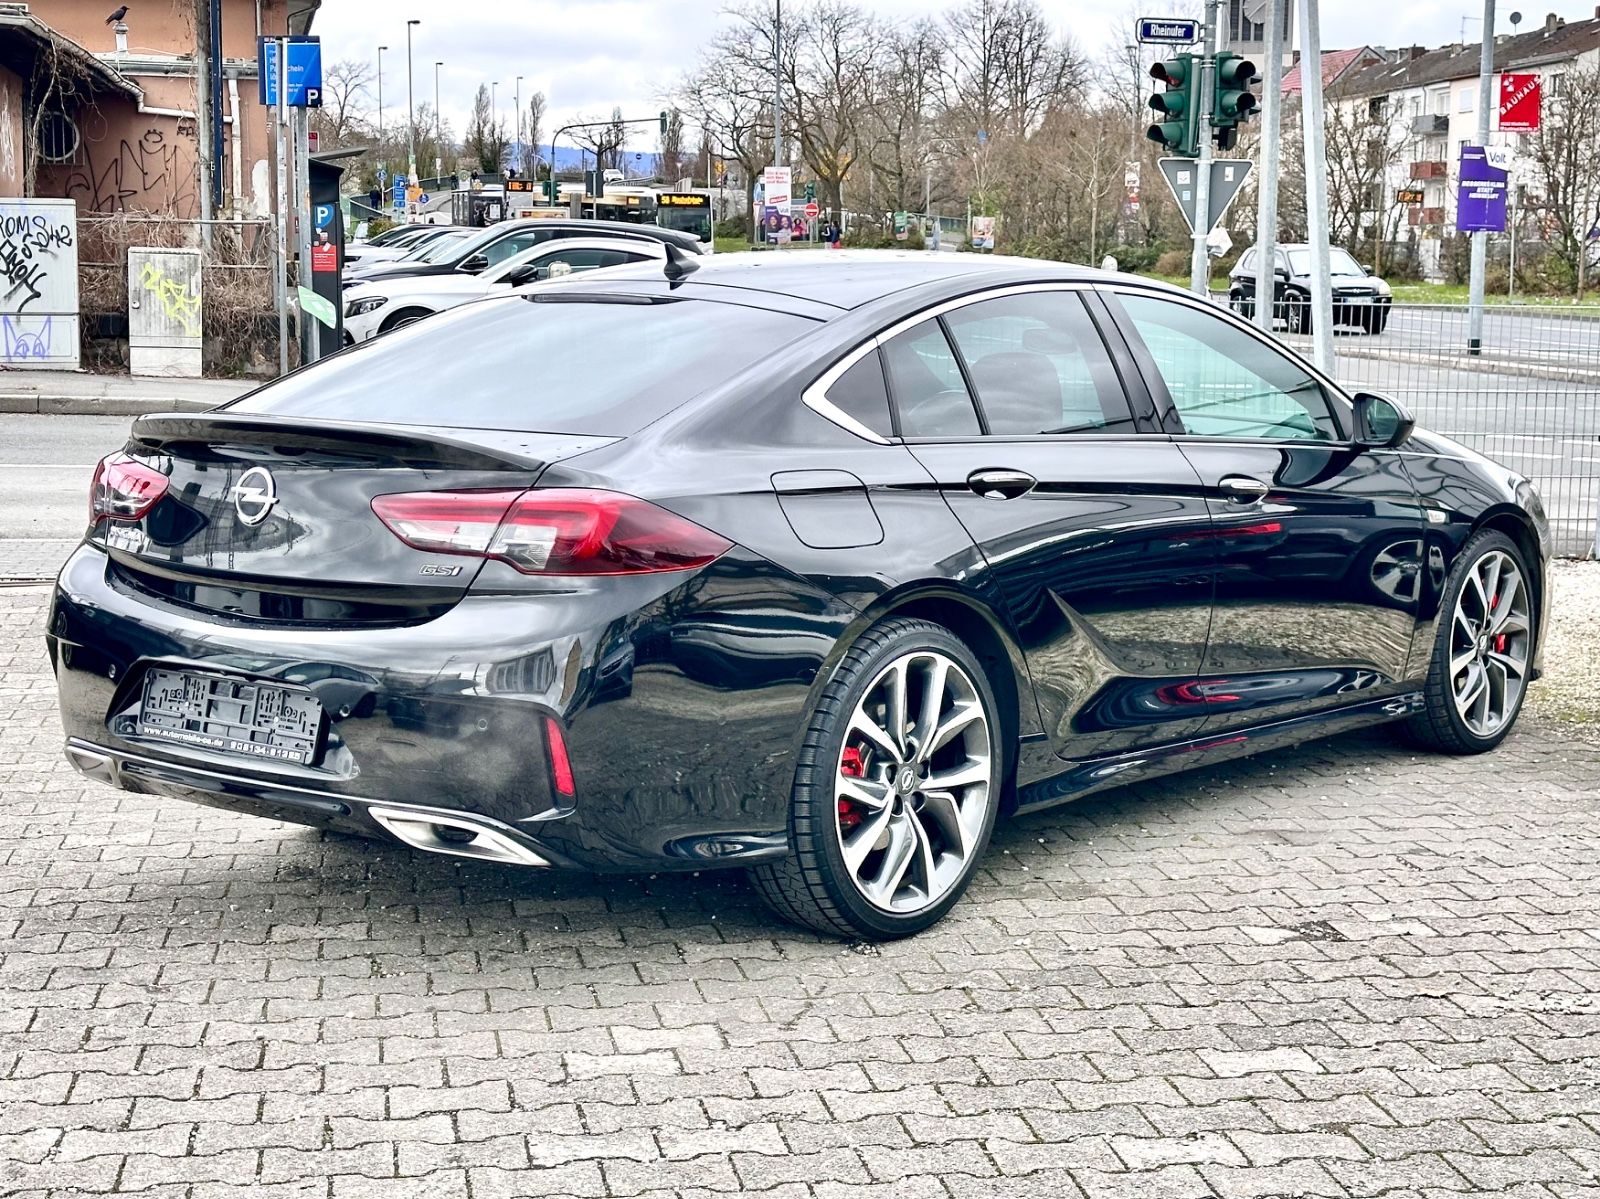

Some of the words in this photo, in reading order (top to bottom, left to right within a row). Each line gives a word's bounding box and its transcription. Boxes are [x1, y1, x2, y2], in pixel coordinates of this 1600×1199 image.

[1150, 23, 1186, 37] Rheinufer
[307, 88, 319, 105] P
[1500, 75, 1541, 116] BAUHAUS
[1489, 151, 1507, 164] Volt
[316, 206, 329, 224] P
